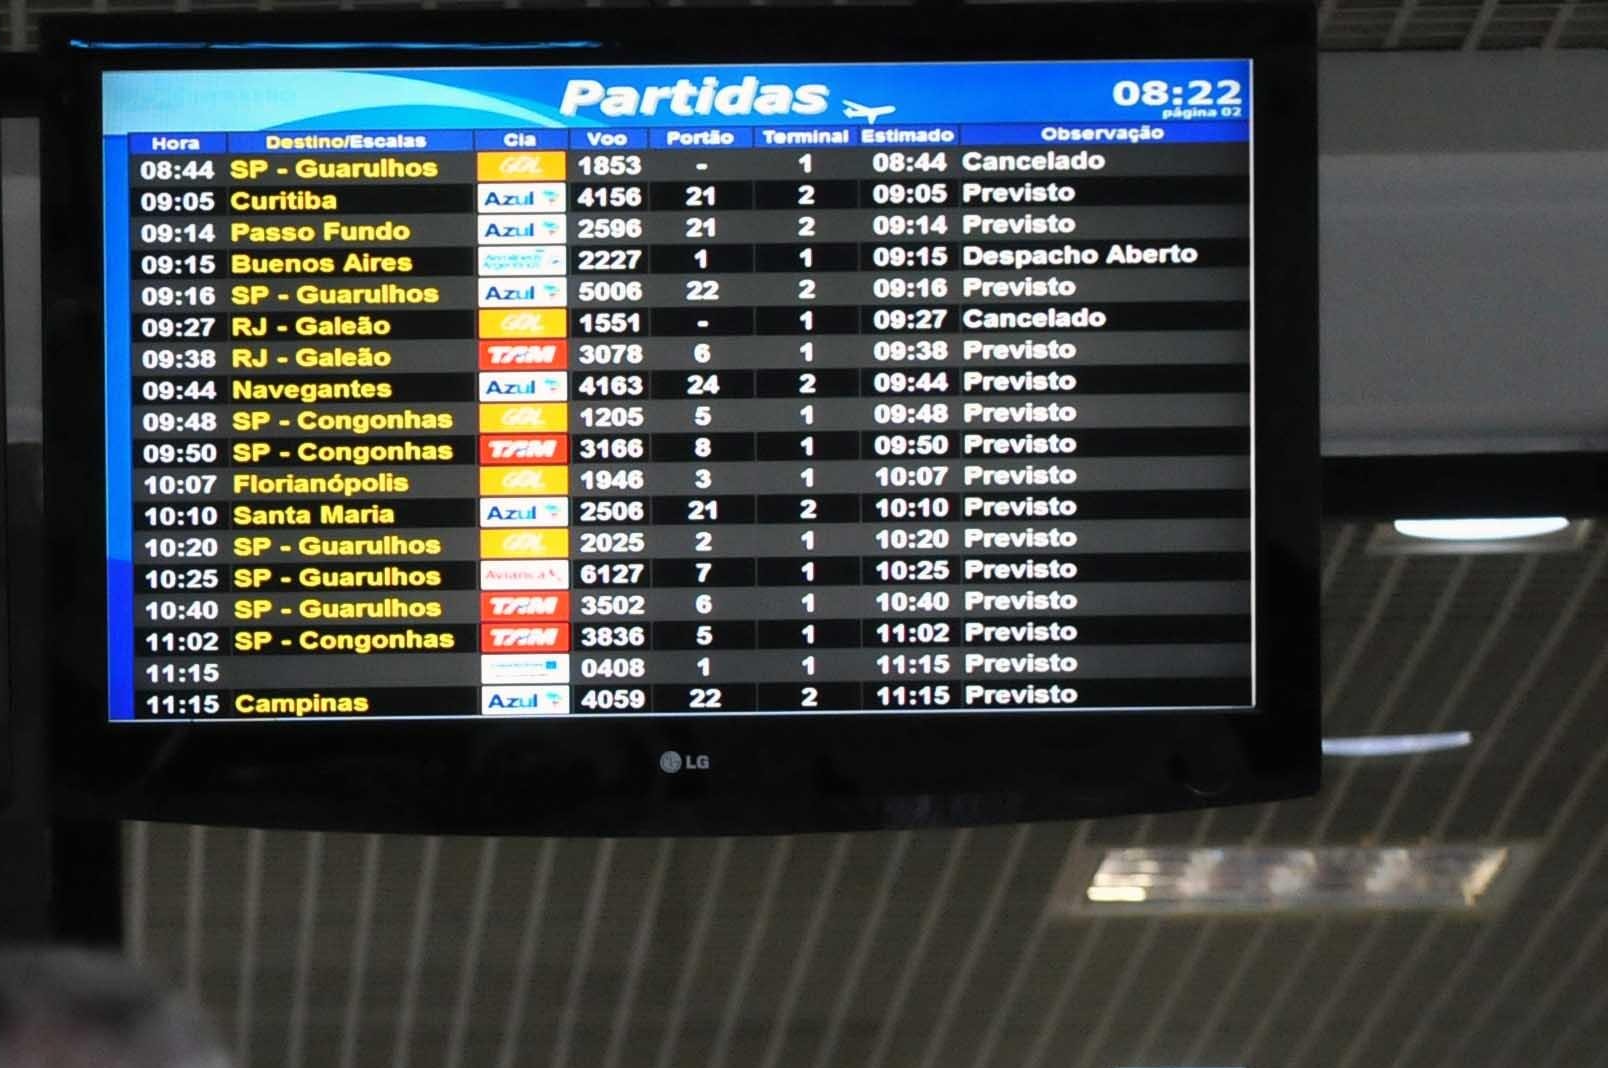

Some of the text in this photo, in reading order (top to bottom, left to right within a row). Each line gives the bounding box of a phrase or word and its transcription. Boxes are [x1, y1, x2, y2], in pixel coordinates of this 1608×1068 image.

[559, 75, 830, 117] Partidas
[1112, 79, 1242, 106] 08:22
[1162, 107, 1242, 120] página 02
[151, 136, 201, 151] Hora
[265, 133, 428, 150] Destino/Escalas
[503, 132, 537, 148] Cia
[586, 131, 628, 147] Voo
[666, 129, 735, 146] Portão
[762, 129, 850, 145] Terminal
[861, 128, 955, 144] Estimado
[1041, 124, 1165, 144] Observação
[872, 151, 948, 173] 08:44
[962, 150, 1106, 172] Cancelado
[140, 191, 215, 212] 09:05
[230, 190, 337, 211] Curitiba
[577, 186, 642, 208] 4156
[685, 186, 716, 206] 21
[231, 220, 411, 243] Passo Fundo
[872, 214, 949, 236] 09:14
[962, 213, 1077, 235] Previsto
[141, 254, 216, 275] 09:15
[231, 252, 413, 274] Buenos Aires
[578, 249, 642, 270] 2227
[963, 244, 1199, 270] Despacho Aberto
[798, 279, 817, 300] 2
[873, 277, 949, 299] 09:16
[142, 317, 216, 338] 09:27
[579, 312, 640, 333] 1551
[962, 307, 1107, 329] Cancelado
[231, 346, 392, 369] RJ Galeão
[693, 343, 712, 364] 6
[873, 340, 949, 362] 09:38
[963, 339, 1077, 361] Previsto
[142, 380, 217, 401] 09:44
[232, 379, 393, 403] Navegantes
[578, 375, 644, 396] 4163
[687, 374, 721, 395] 24
[232, 409, 454, 435] SP Congonhas
[873, 403, 950, 425] 09:48
[143, 443, 217, 464] 09:50
[579, 438, 644, 459] 3166
[233, 472, 410, 497] Florianópolis
[875, 465, 950, 487] 10:07
[964, 464, 1078, 486] Previsto
[144, 506, 218, 526] 10:10
[233, 504, 395, 525] Santa Maria
[580, 501, 644, 522] 2506
[875, 528, 950, 550] 10:20
[145, 569, 219, 589] 10:25
[580, 563, 645, 584] 6127
[695, 562, 712, 583] 7
[875, 591, 950, 612] 10:40
[964, 590, 1078, 611] Previsto
[145, 631, 219, 652] 11:02
[581, 626, 645, 647] 3836
[876, 653, 951, 675] 11:15
[146, 694, 220, 714] 11:15
[235, 693, 369, 717] Campinas
[487, 693, 538, 709] Azul
[580, 689, 646, 709] 4059
[801, 687, 818, 707] 2
